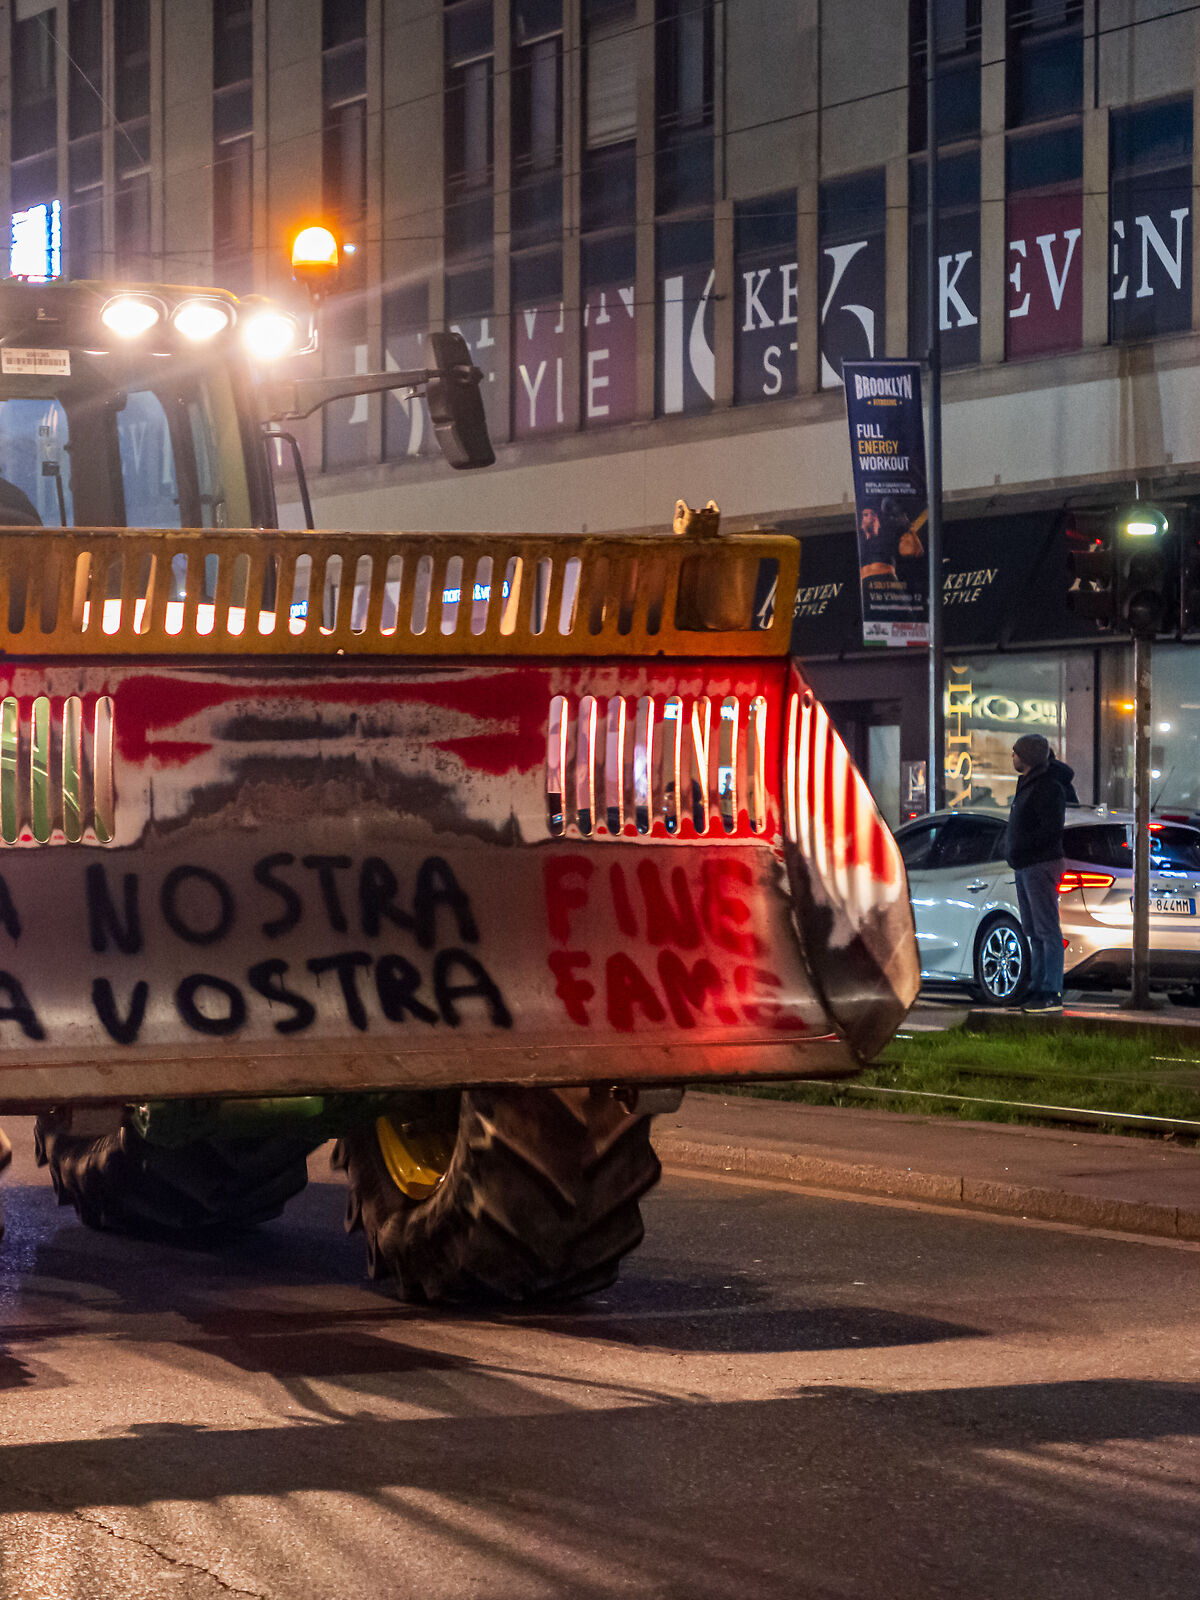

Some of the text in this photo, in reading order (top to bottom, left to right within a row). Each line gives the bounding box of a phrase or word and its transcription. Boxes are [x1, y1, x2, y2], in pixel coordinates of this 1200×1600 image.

[854, 373, 913, 400] BROOKLYN
[856, 423, 884, 438] FULL
[858, 439, 899, 455] ENERGY
[859, 455, 910, 471] WORKOUT
[942, 568, 999, 590] KEVEN
[794, 583, 844, 604] KEVEN
[942, 587, 983, 606] STYLE
[791, 601, 829, 618] STYLE
[85, 851, 481, 956] NOSTRA
[543, 853, 768, 960] FINE
[91, 947, 515, 1046] VOSTRA
[547, 949, 809, 1034] FAME
